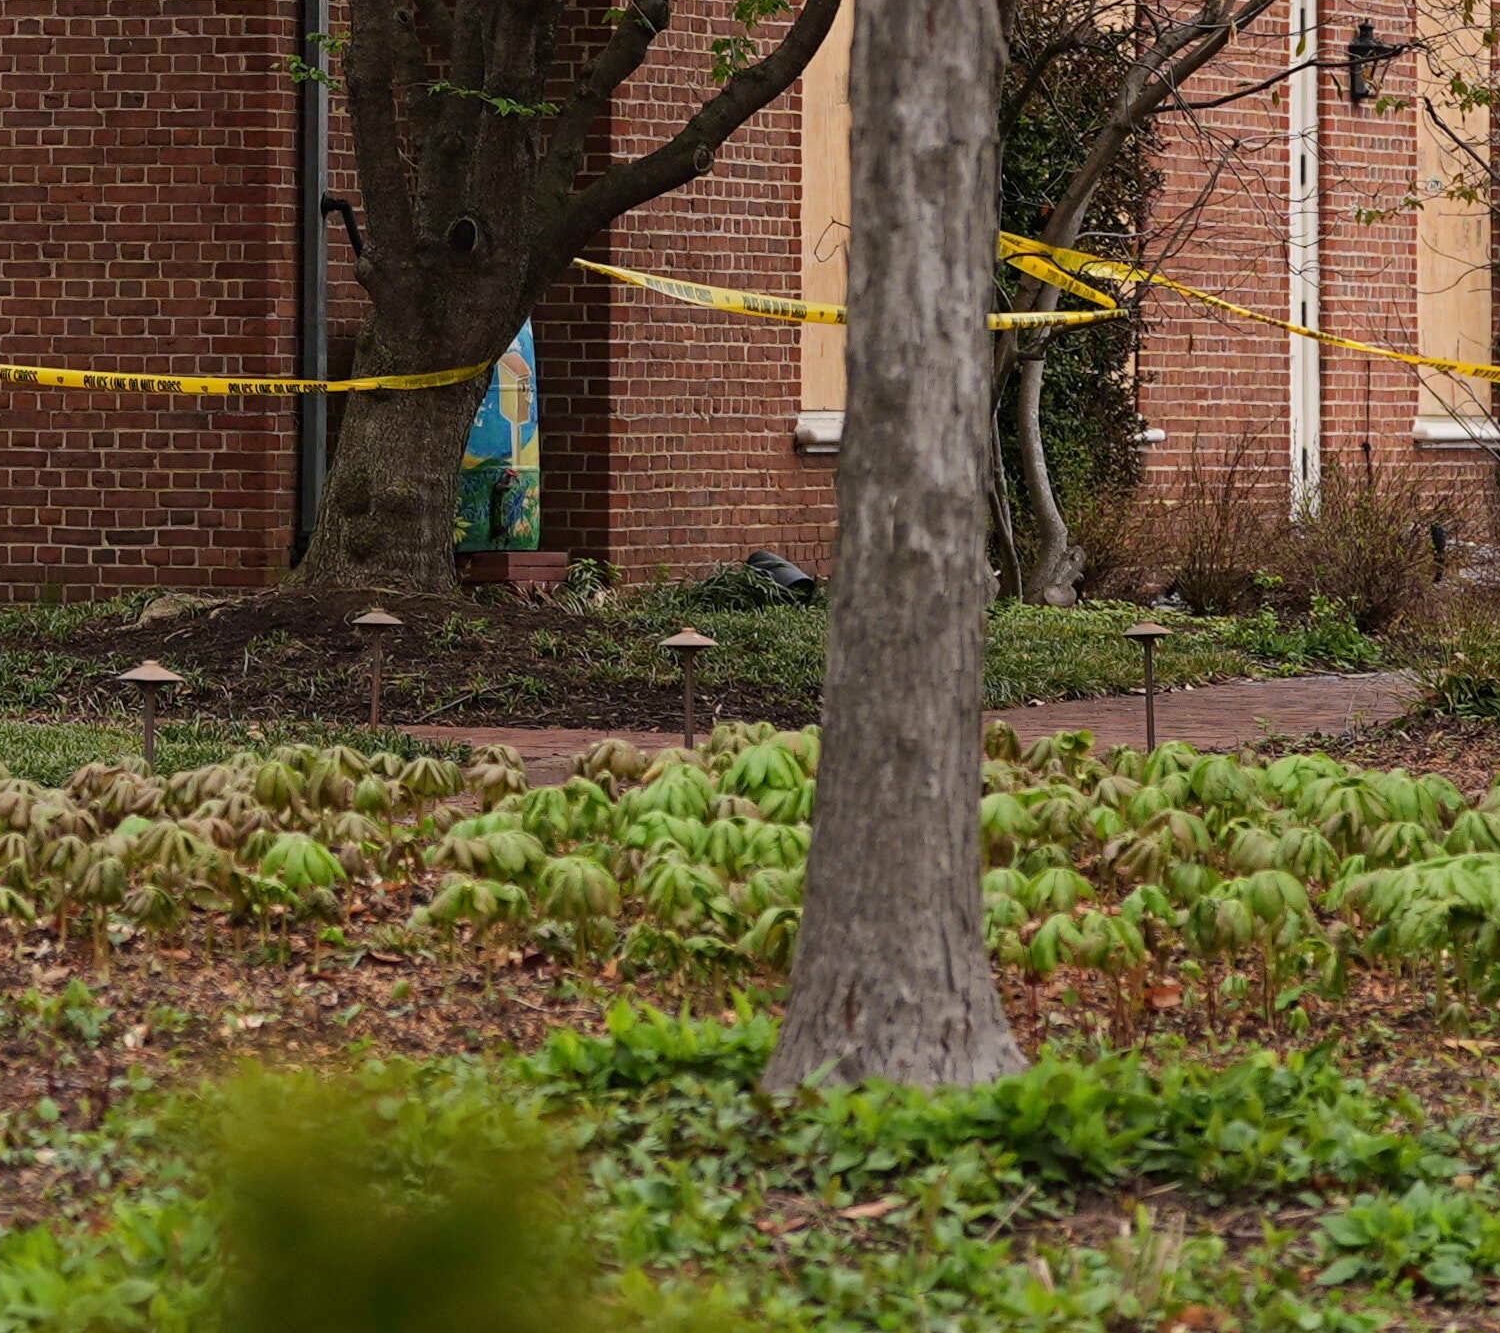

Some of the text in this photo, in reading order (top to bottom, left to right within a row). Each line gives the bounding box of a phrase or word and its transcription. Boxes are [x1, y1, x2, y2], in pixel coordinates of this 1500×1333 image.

[13, 368, 38, 382] CROSS
[84, 375, 183, 393] POLICE LINE DO NOT CROSS
[228, 382, 253, 395] POLICE
[255, 383, 272, 395] LINE
[286, 383, 300, 395] NOT
[303, 383, 328, 395] CROSS
